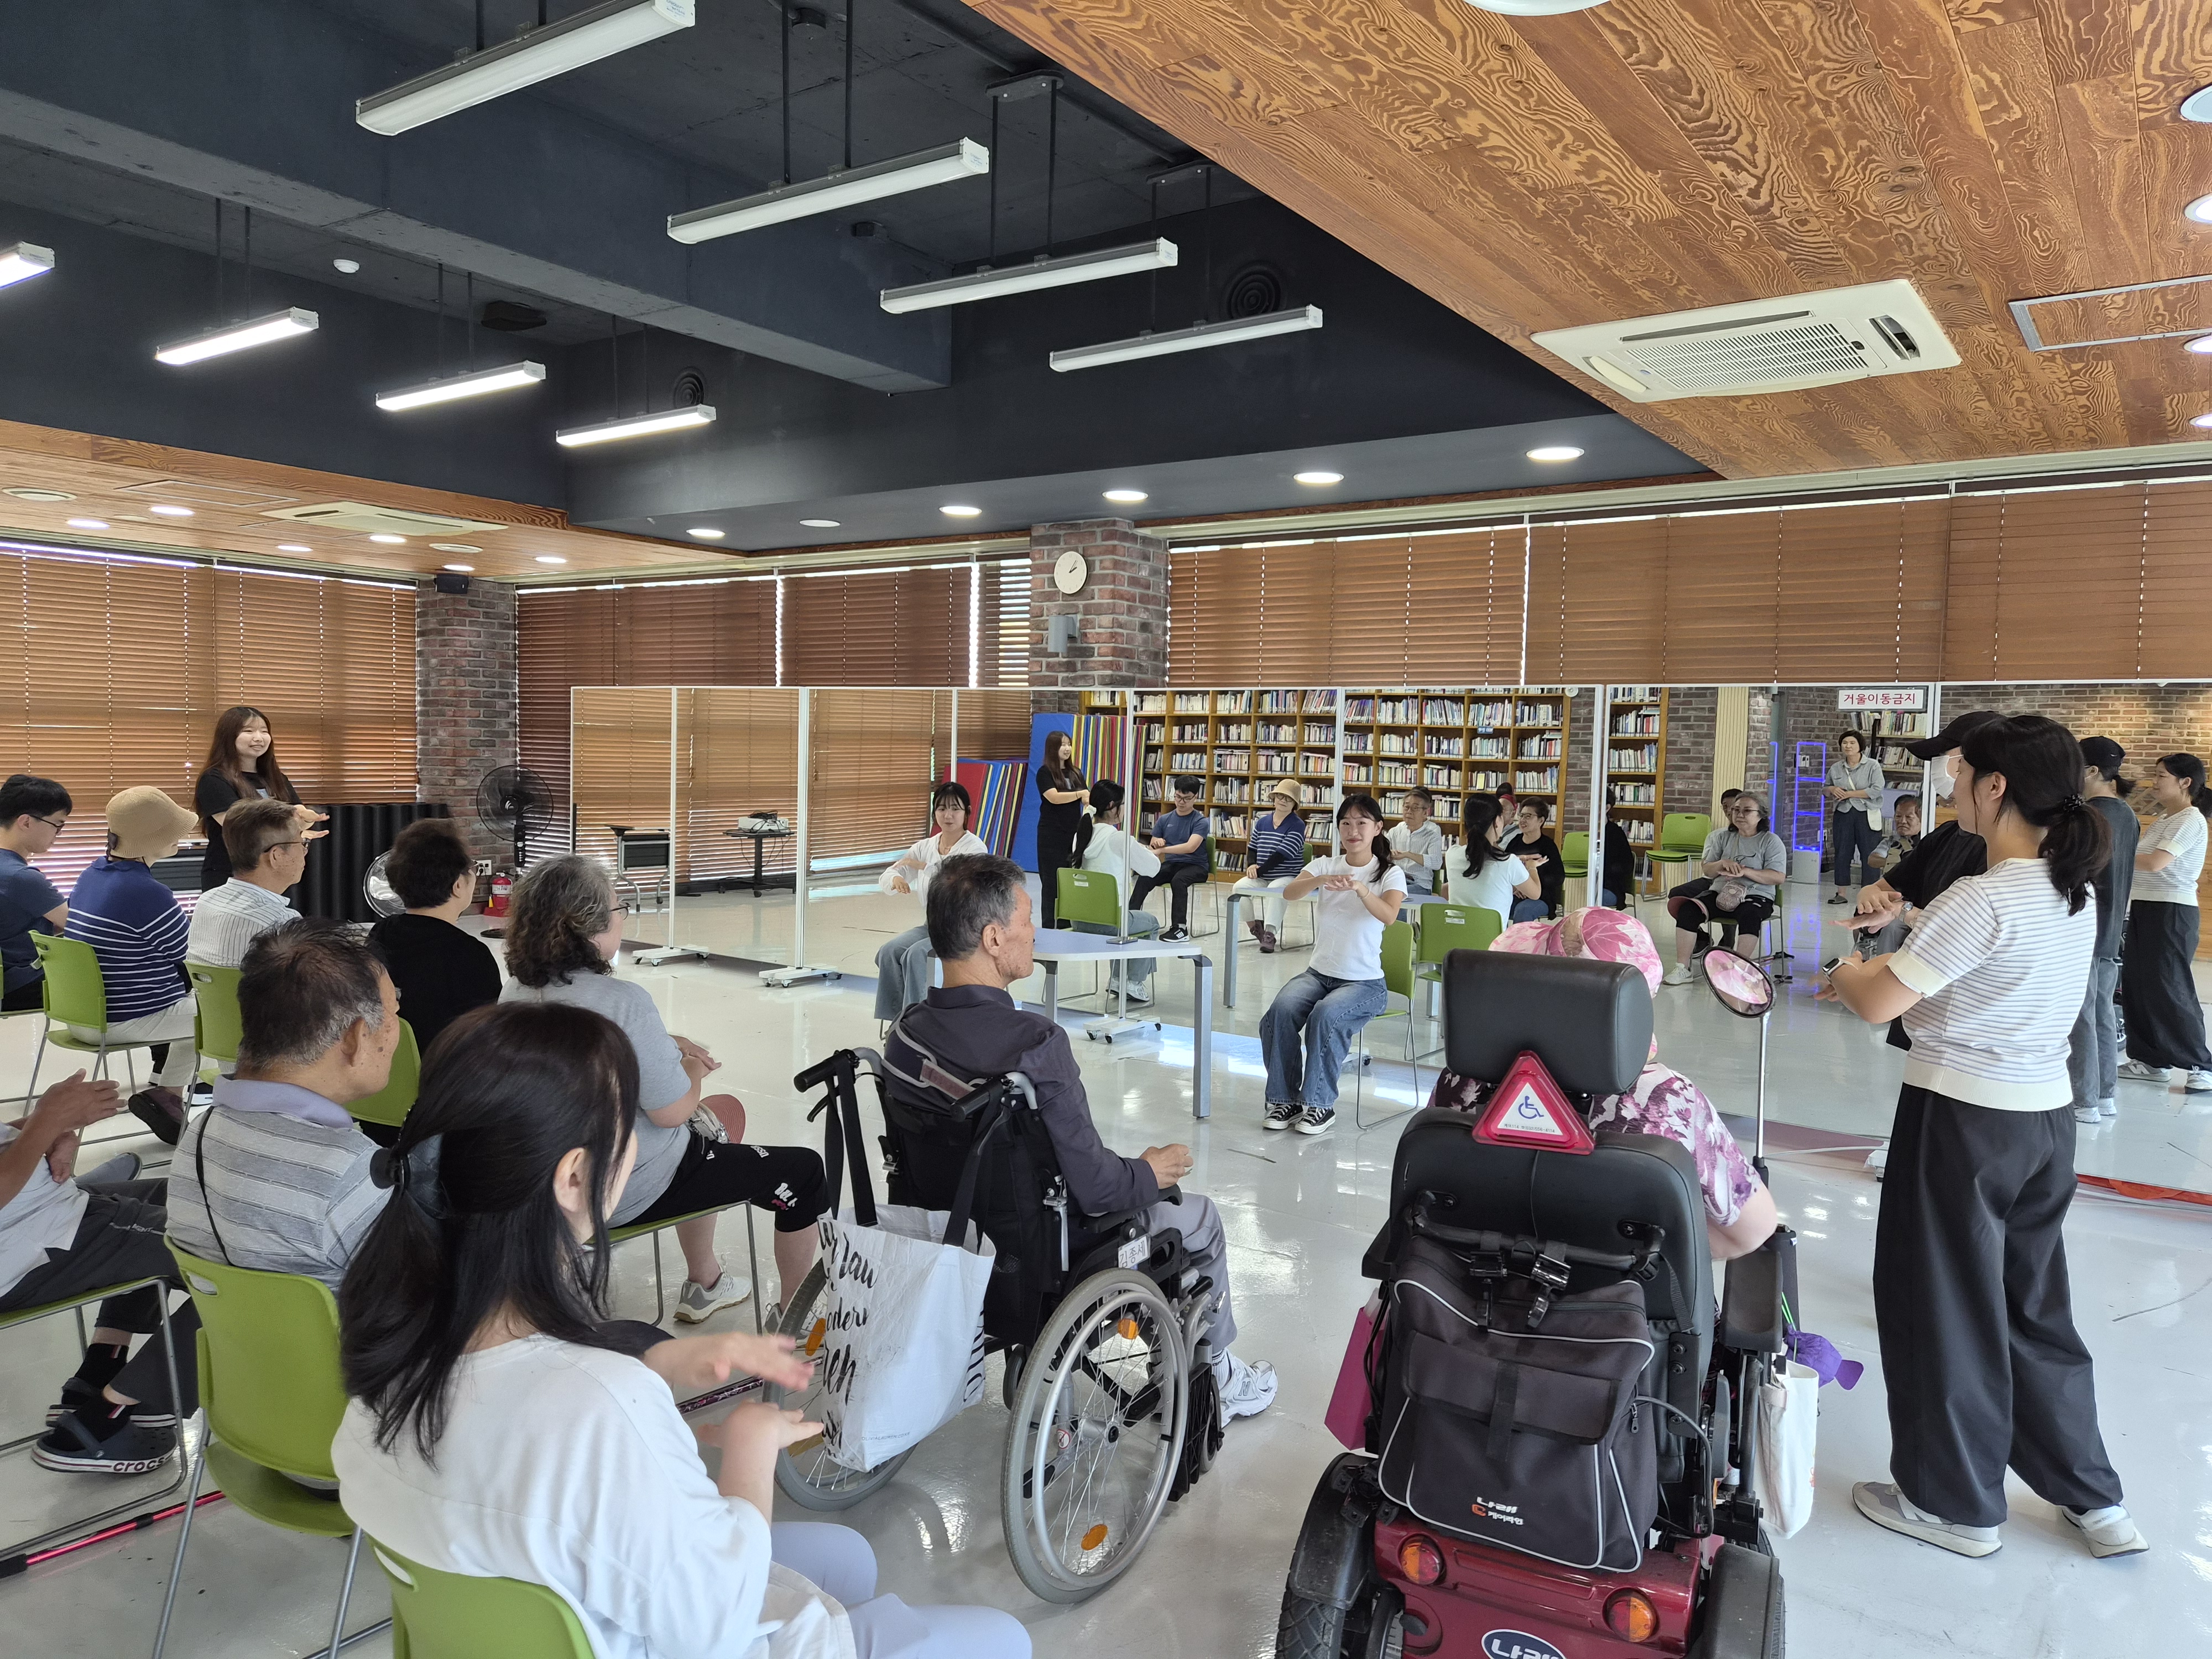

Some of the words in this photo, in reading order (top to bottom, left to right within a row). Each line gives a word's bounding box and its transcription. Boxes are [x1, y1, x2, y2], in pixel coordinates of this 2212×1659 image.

[1843, 693, 1916, 705] 거울이동금지
[1120, 1240, 1146, 1267] 김종세
[113, 1457, 165, 1472] crocs
[1477, 1496, 1518, 1514] 나래
[1488, 1511, 1524, 1525] 케어라인
